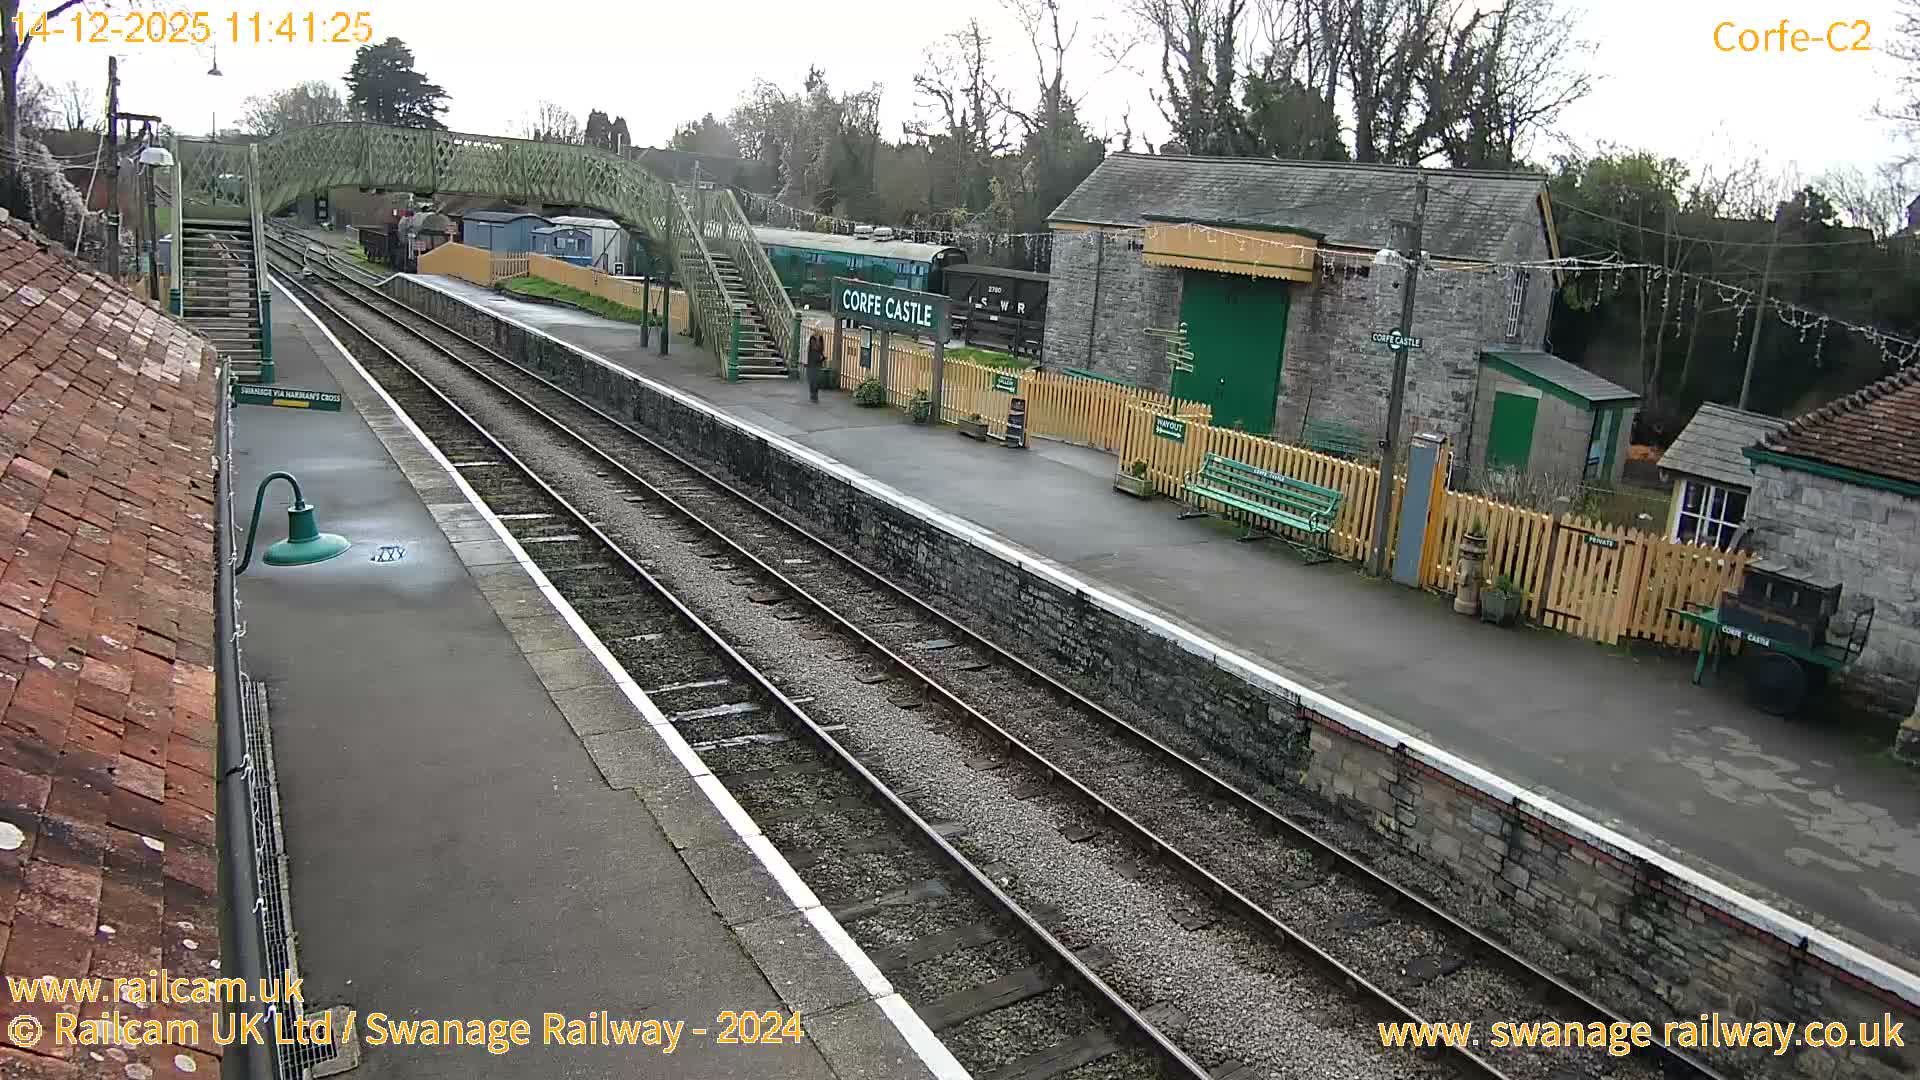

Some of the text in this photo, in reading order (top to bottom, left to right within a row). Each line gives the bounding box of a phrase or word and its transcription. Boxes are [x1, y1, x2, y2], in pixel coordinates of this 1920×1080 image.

[842, 289, 933, 327] CORFE CASTLE
[1372, 333, 1421, 348] CORFE CASTLE
[272, 389, 285, 398] VIA
[320, 393, 341, 403] CROSS
